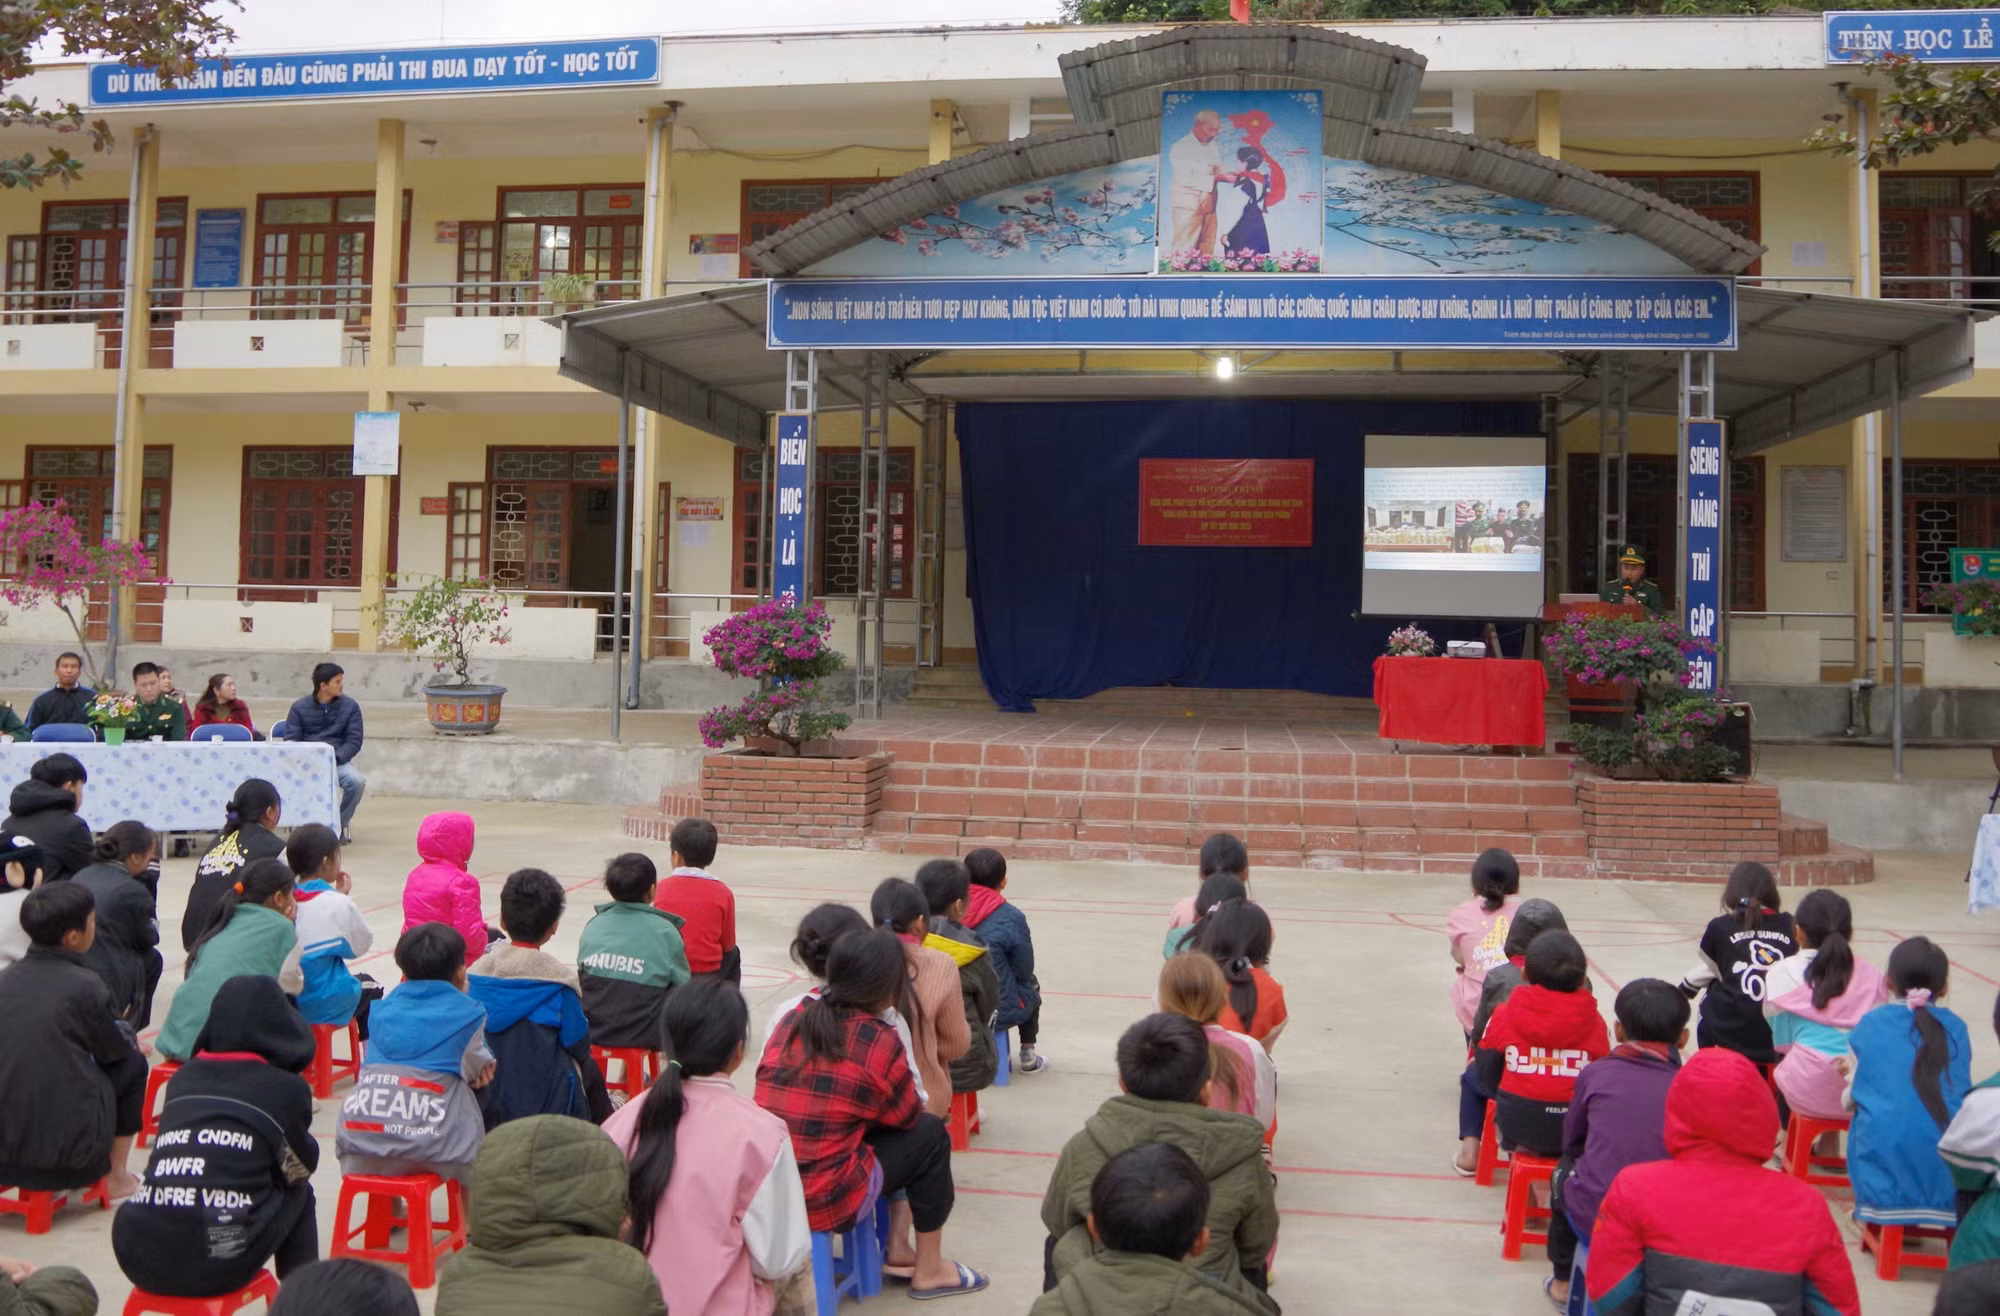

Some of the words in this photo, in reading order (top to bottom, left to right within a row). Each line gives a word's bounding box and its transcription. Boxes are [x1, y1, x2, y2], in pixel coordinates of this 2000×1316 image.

[1904, 29, 1952, 55] HỌC
[1963, 18, 1993, 48] LỄ
[107, 69, 130, 94] DÙ
[222, 62, 256, 88] ĐẾN
[262, 62, 296, 86] ĐÂU
[301, 60, 348, 84] CŨNG
[353, 55, 394, 82] PHẢI
[399, 60, 427, 80] THI
[432, 58, 468, 79] ĐUA
[474, 56, 507, 81] DẠY
[513, 48, 547, 75] TỐT
[563, 52, 600, 76] HỌC
[605, 45, 639, 70] TỐT
[811, 296, 833, 320] SÔNG
[836, 296, 852, 324] VIỆT
[854, 300, 873, 320] NAM
[875, 295, 885, 320] CÓ
[905, 295, 922, 319] NÊN
[944, 299, 960, 323] ĐẸP
[962, 299, 979, 318] HAY
[980, 295, 1010, 320] KHÔNG,
[1012, 295, 1030, 318] DÂN
[1032, 294, 1047, 323] TỘC
[1050, 294, 1067, 323] VIỆT
[1069, 299, 1089, 318] NAM
[1091, 293, 1102, 318] CÓ
[1104, 293, 1125, 318] BƯỚC
[1128, 293, 1141, 318] TỚI
[1159, 299, 1178, 318] VINH
[1180, 299, 1209, 320] QUANG
[1224, 294, 1247, 318] SÁNH
[1249, 299, 1261, 318] VAI
[1263, 293, 1276, 318] VỚI
[1278, 294, 1295, 318] CÁC
[1327, 293, 1349, 320] QUỐC
[1351, 295, 1371, 318] NĂM
[1373, 295, 1395, 318] CHÂU
[1398, 297, 1420, 323] ĐƯỢC
[1422, 299, 1438, 318] HAY
[1472, 295, 1497, 318] CHÍNH
[1501, 295, 1512, 318] LÀ
[1514, 293, 1532, 318] NHỜ
[1534, 295, 1552, 323] MỘT
[1589, 295, 1613, 319] CÔNG
[1615, 299, 1632, 323] HỌC
[1636, 295, 1652, 323] TẬP
[1654, 293, 1672, 319] CỦA
[1675, 295, 1692, 319] CÁC
[780, 425, 807, 465] BIỂN
[1690, 440, 1719, 476] SIÊNG
[780, 488, 802, 521] HỌC
[1690, 491, 1718, 528] NĂNG
[782, 530, 796, 566] LÀ
[1692, 547, 1710, 581] THÌ
[197, 1129, 253, 1151] CNDFM
[384, 1123, 402, 1134] NOT
[154, 1157, 205, 1177] BWFR
[154, 1187, 196, 1206] DFRE
